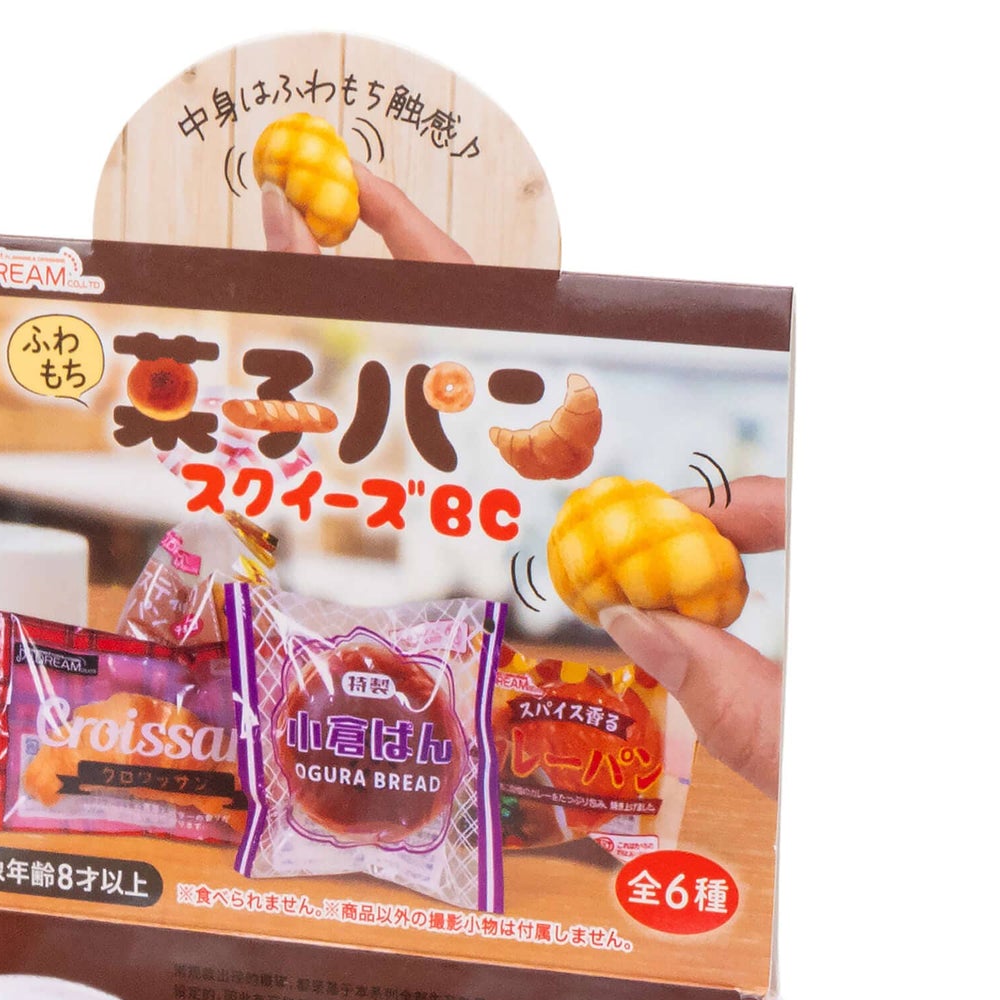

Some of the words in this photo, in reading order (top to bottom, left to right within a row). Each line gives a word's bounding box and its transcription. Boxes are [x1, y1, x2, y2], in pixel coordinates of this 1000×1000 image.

[22, 325, 80, 355] ふわ
[40, 357, 87, 389] もち
[181, 462, 522, 541] スクイーズBC
[348, 675, 392, 696] 特製
[520, 701, 620, 733] スパイス香る
[286, 711, 453, 765] 小倉ぱん
[510, 726, 664, 793] レーパン
[102, 766, 209, 793] クロワッサン
[295, 763, 365, 788] OGURA
[373, 771, 441, 794] BREAD
[627, 869, 730, 915] 全6種
